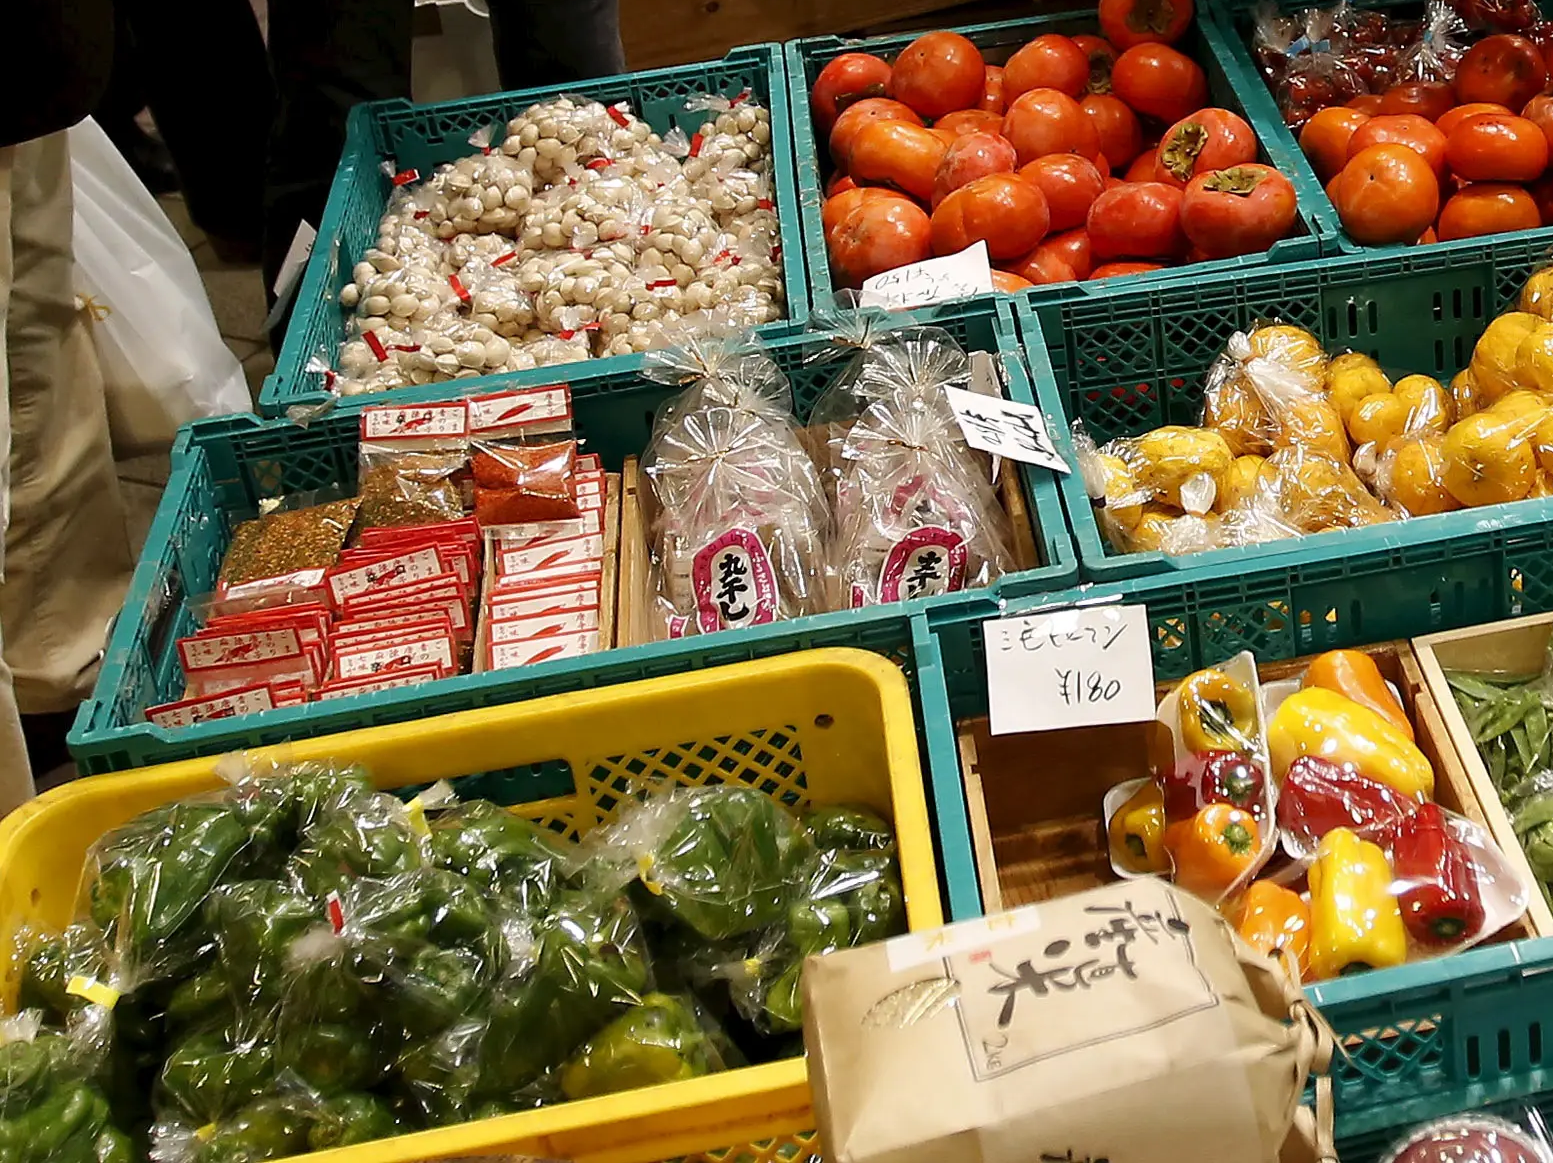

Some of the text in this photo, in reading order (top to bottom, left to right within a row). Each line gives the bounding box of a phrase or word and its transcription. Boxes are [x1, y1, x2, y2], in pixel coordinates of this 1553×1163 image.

[716, 553, 750, 621] 丸干し
[1054, 668, 1121, 705] ¥180
